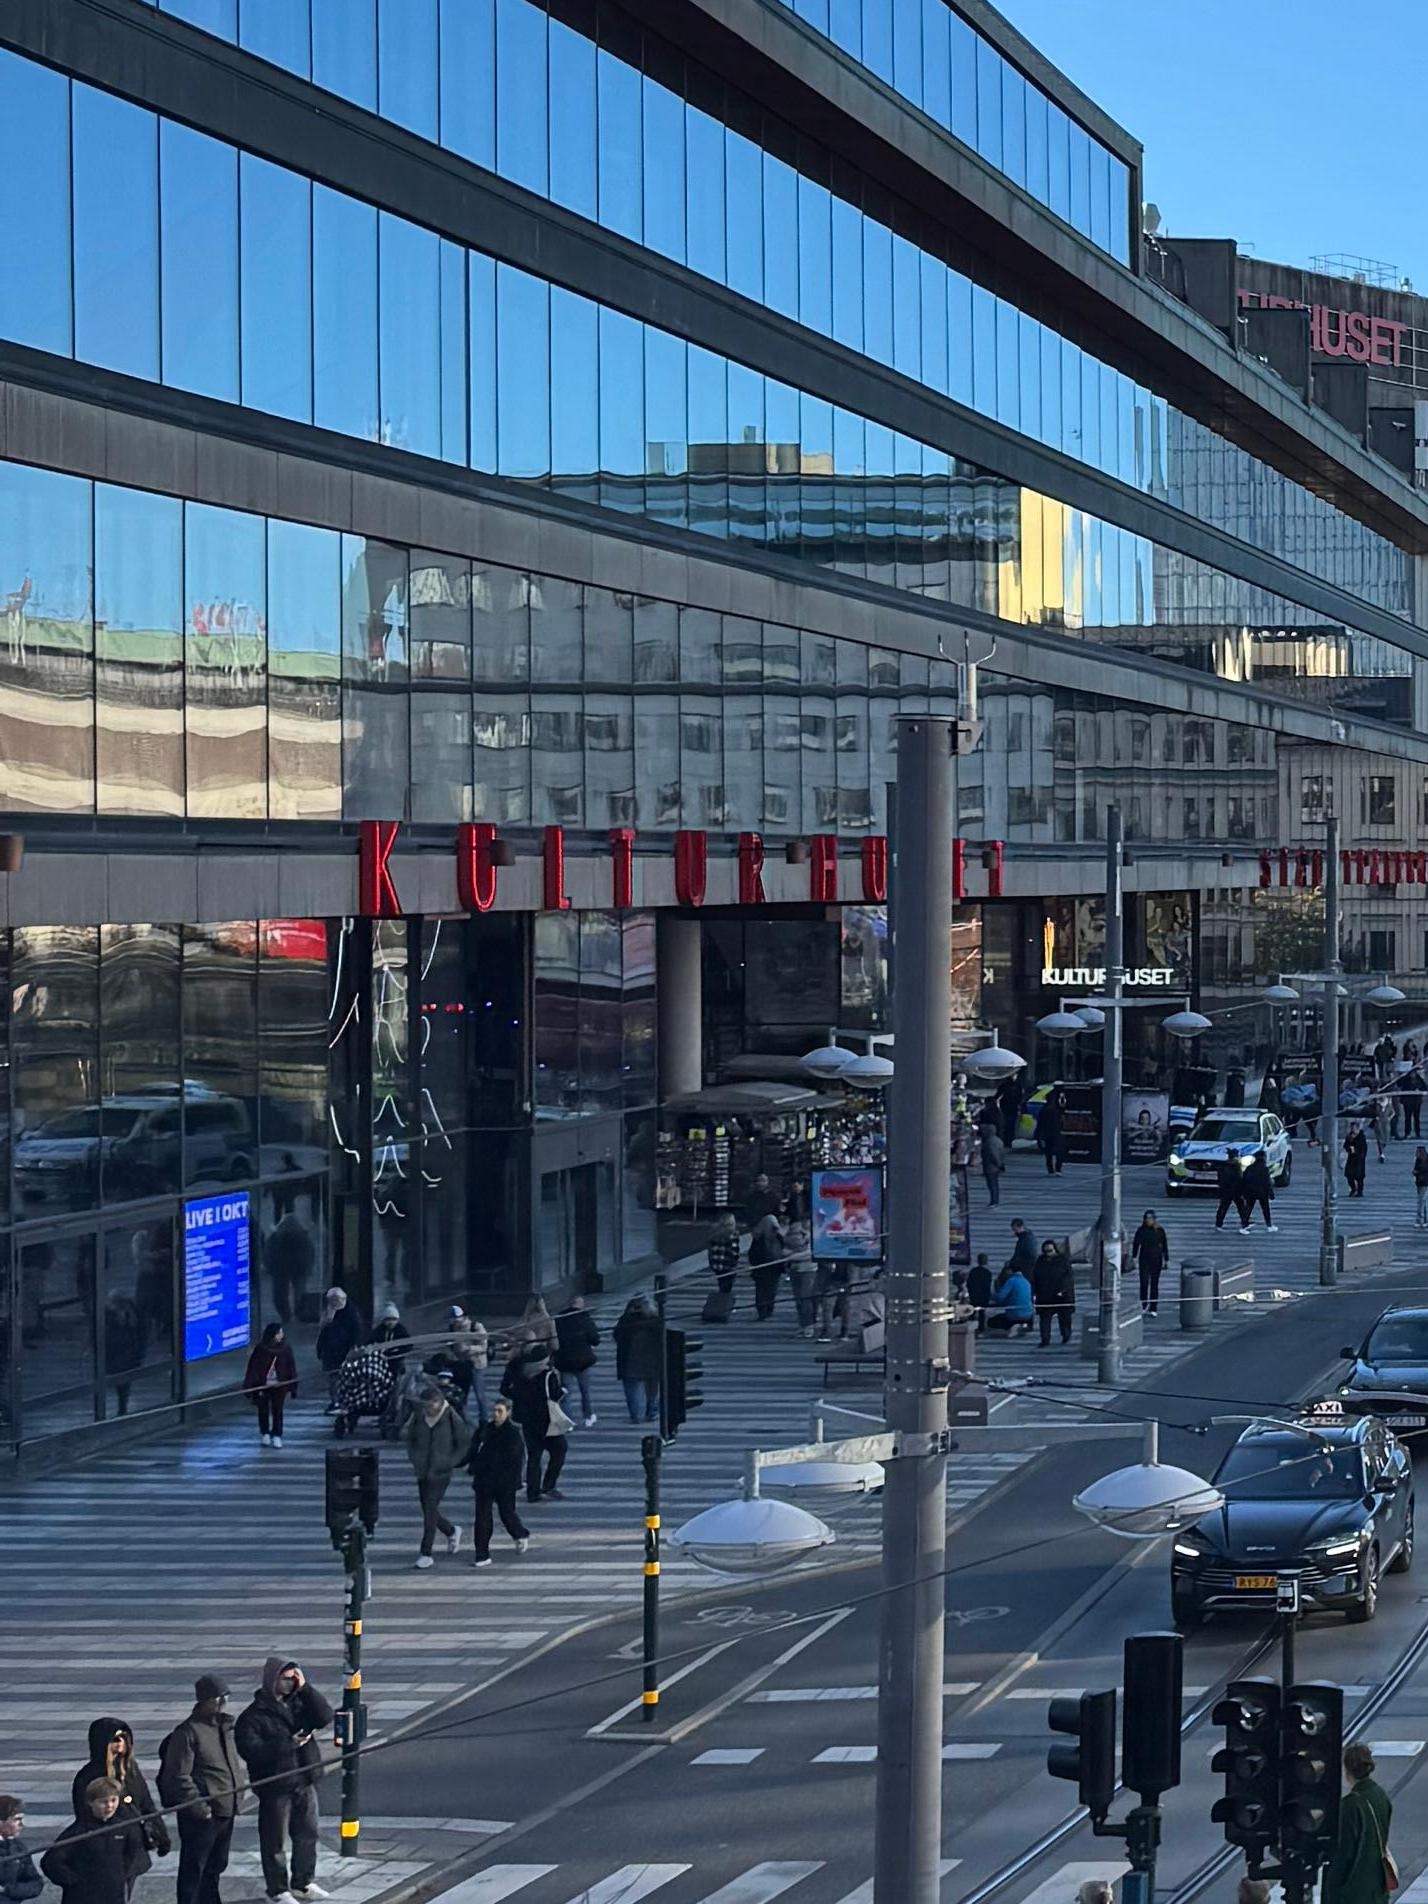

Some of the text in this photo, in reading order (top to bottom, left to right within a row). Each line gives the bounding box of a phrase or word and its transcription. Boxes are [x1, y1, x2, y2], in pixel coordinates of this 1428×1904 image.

[359, 820, 1005, 917] KULTURHUET
[1041, 967, 1175, 986] KULTURUSET
[185, 1207, 213, 1229] LIVE
[222, 1200, 249, 1222] OKT
